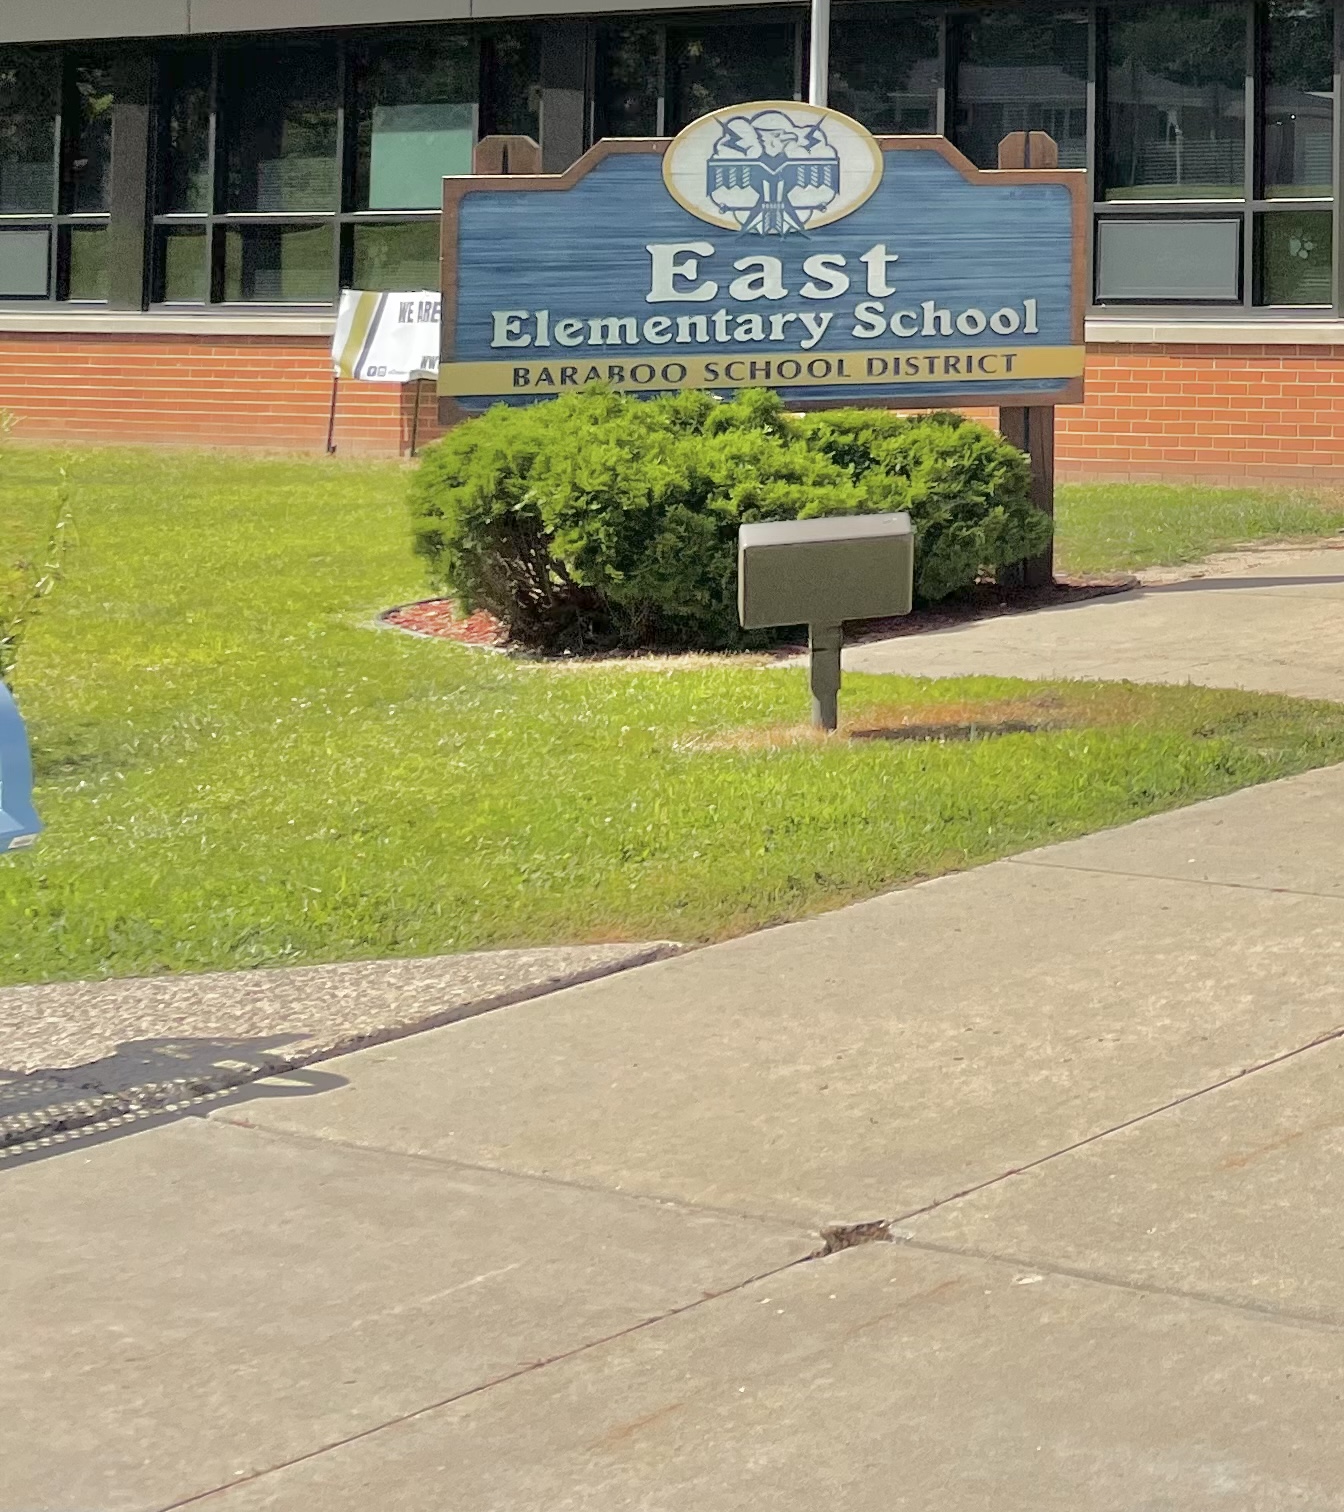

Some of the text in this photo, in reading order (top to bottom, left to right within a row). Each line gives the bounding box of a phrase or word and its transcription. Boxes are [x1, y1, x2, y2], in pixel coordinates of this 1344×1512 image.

[645, 242, 900, 302] East
[398, 301, 414, 323] WE
[490, 298, 1039, 350] Elementary School
[512, 353, 1018, 388] BARABOO SCHOOL DISTRICT
